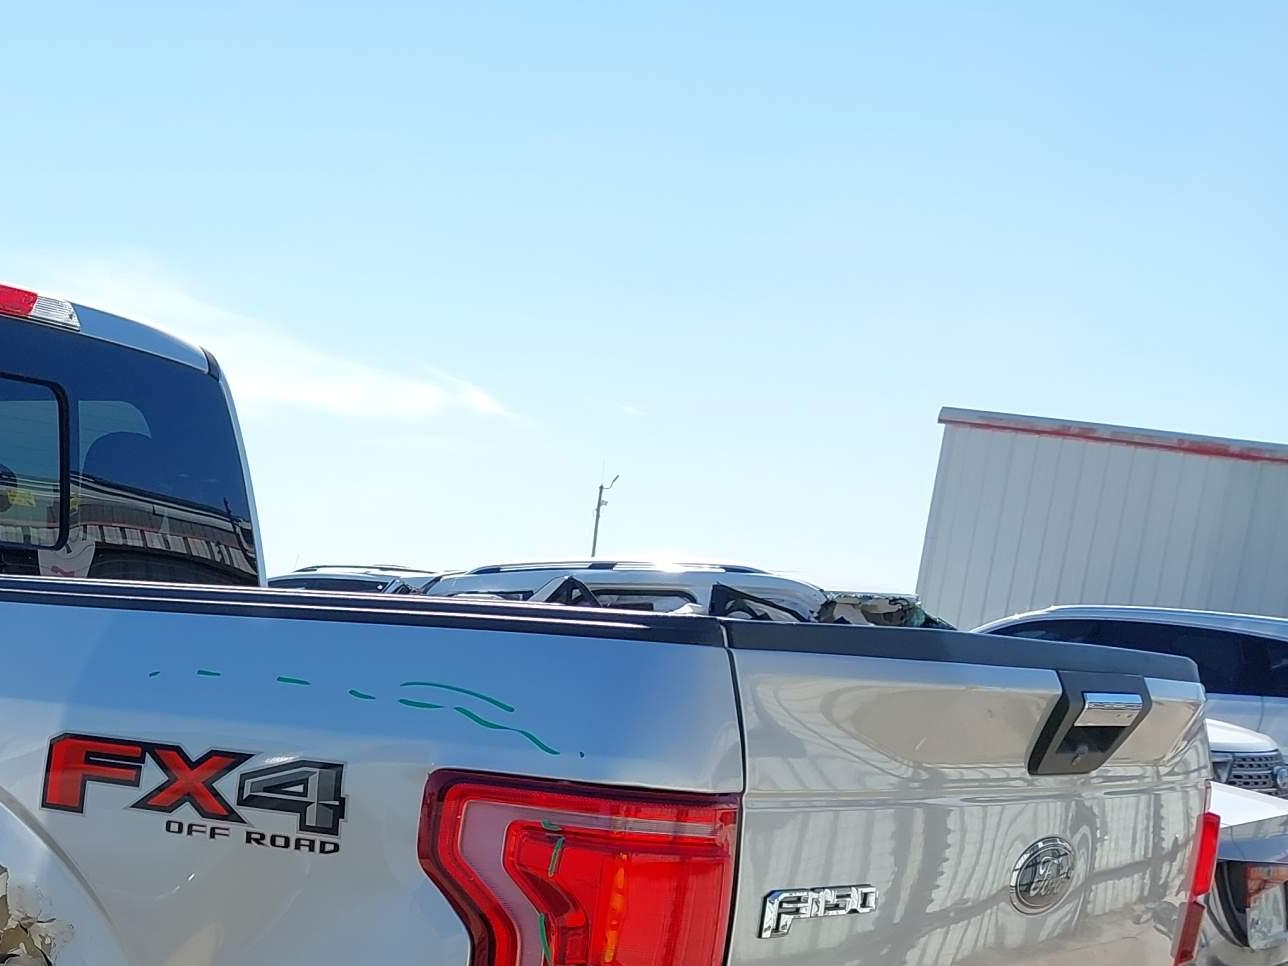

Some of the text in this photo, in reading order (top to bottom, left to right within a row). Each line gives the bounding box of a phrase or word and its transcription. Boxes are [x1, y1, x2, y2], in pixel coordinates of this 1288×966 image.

[41, 731, 346, 837] FX4
[165, 820, 340, 854] OFF ROAD
[758, 884, 878, 939] F150
